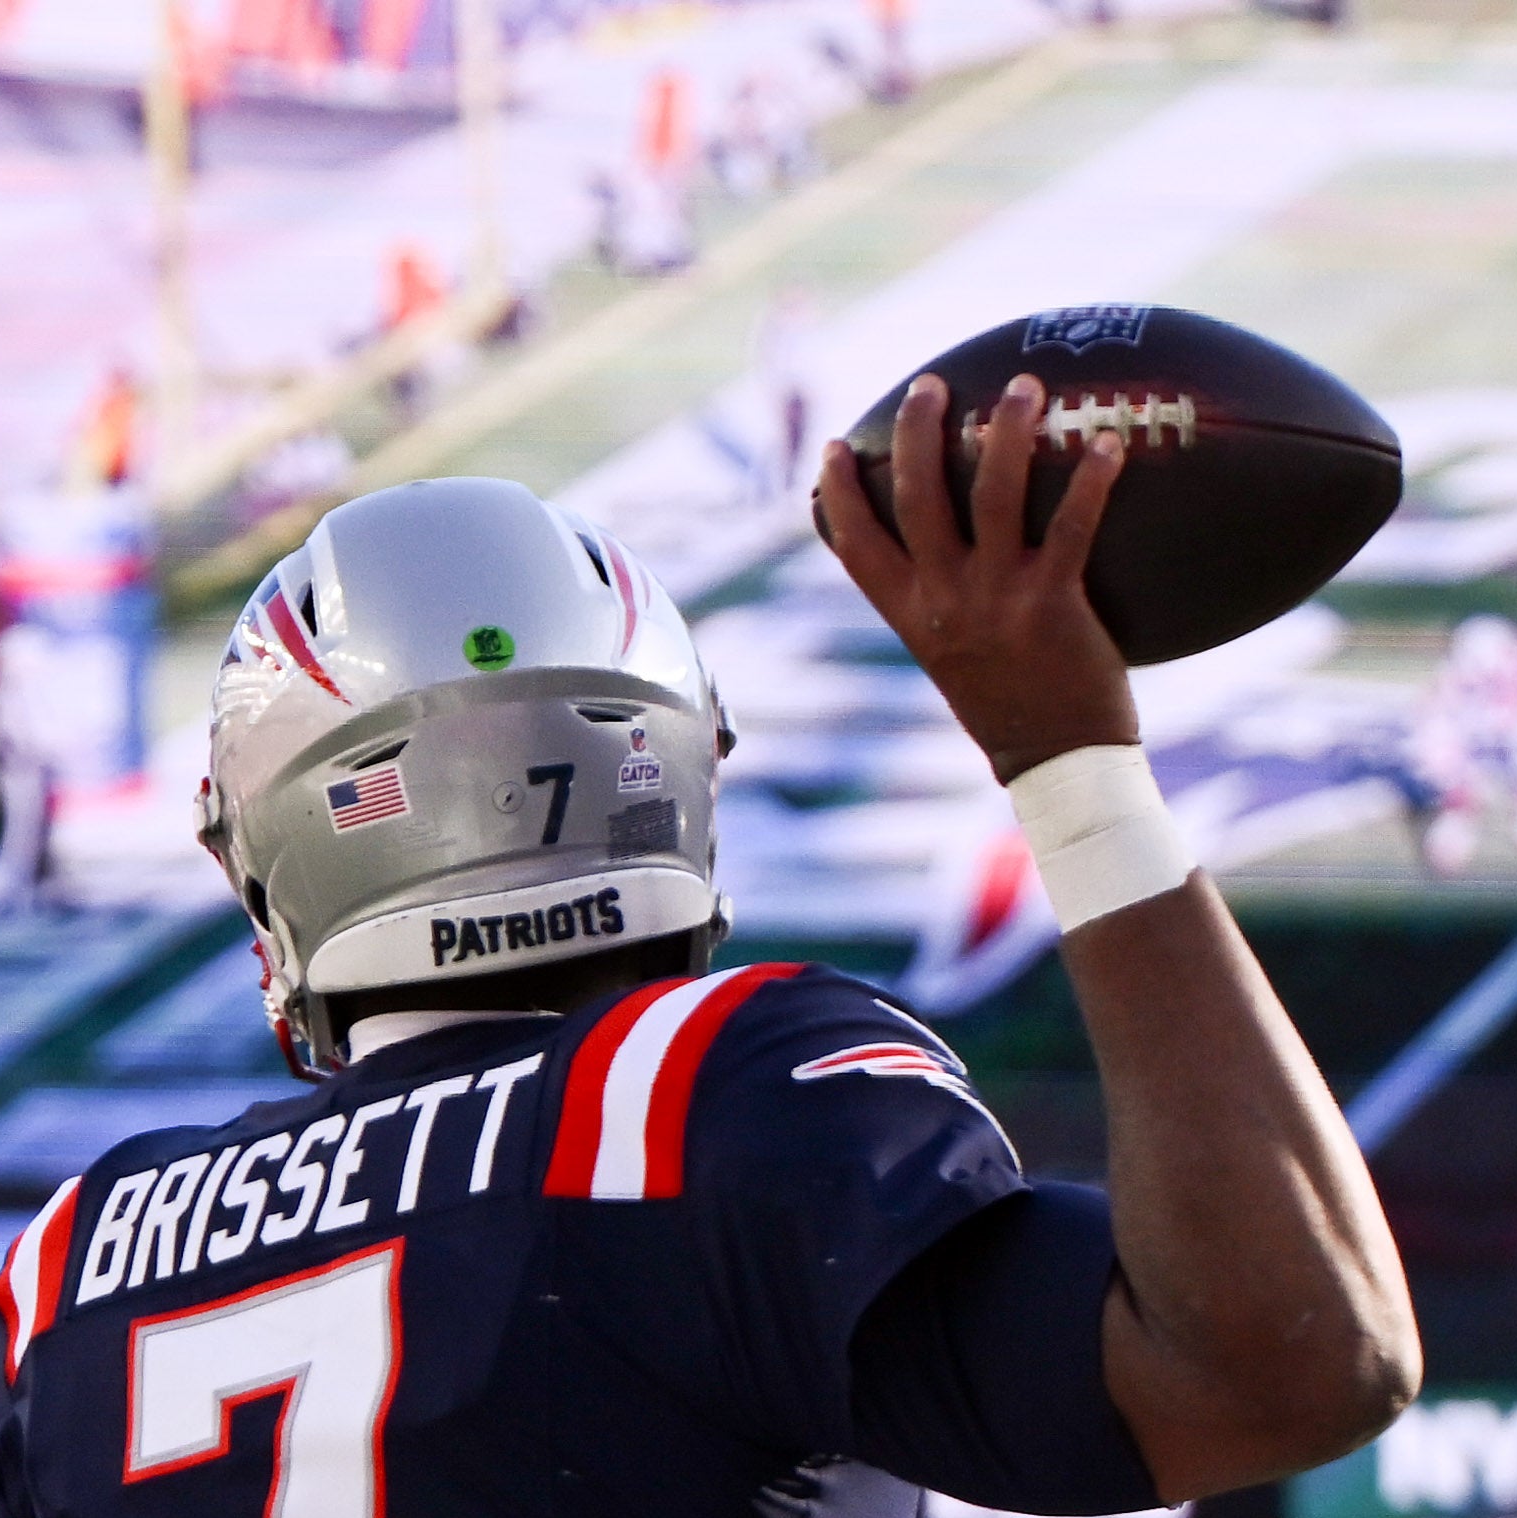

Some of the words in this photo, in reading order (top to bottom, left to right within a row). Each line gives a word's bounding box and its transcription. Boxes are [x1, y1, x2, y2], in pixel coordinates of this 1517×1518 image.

[526, 762, 574, 845] 7
[430, 886, 624, 967] PATRIOTS
[76, 1052, 545, 1306] BRISSETT
